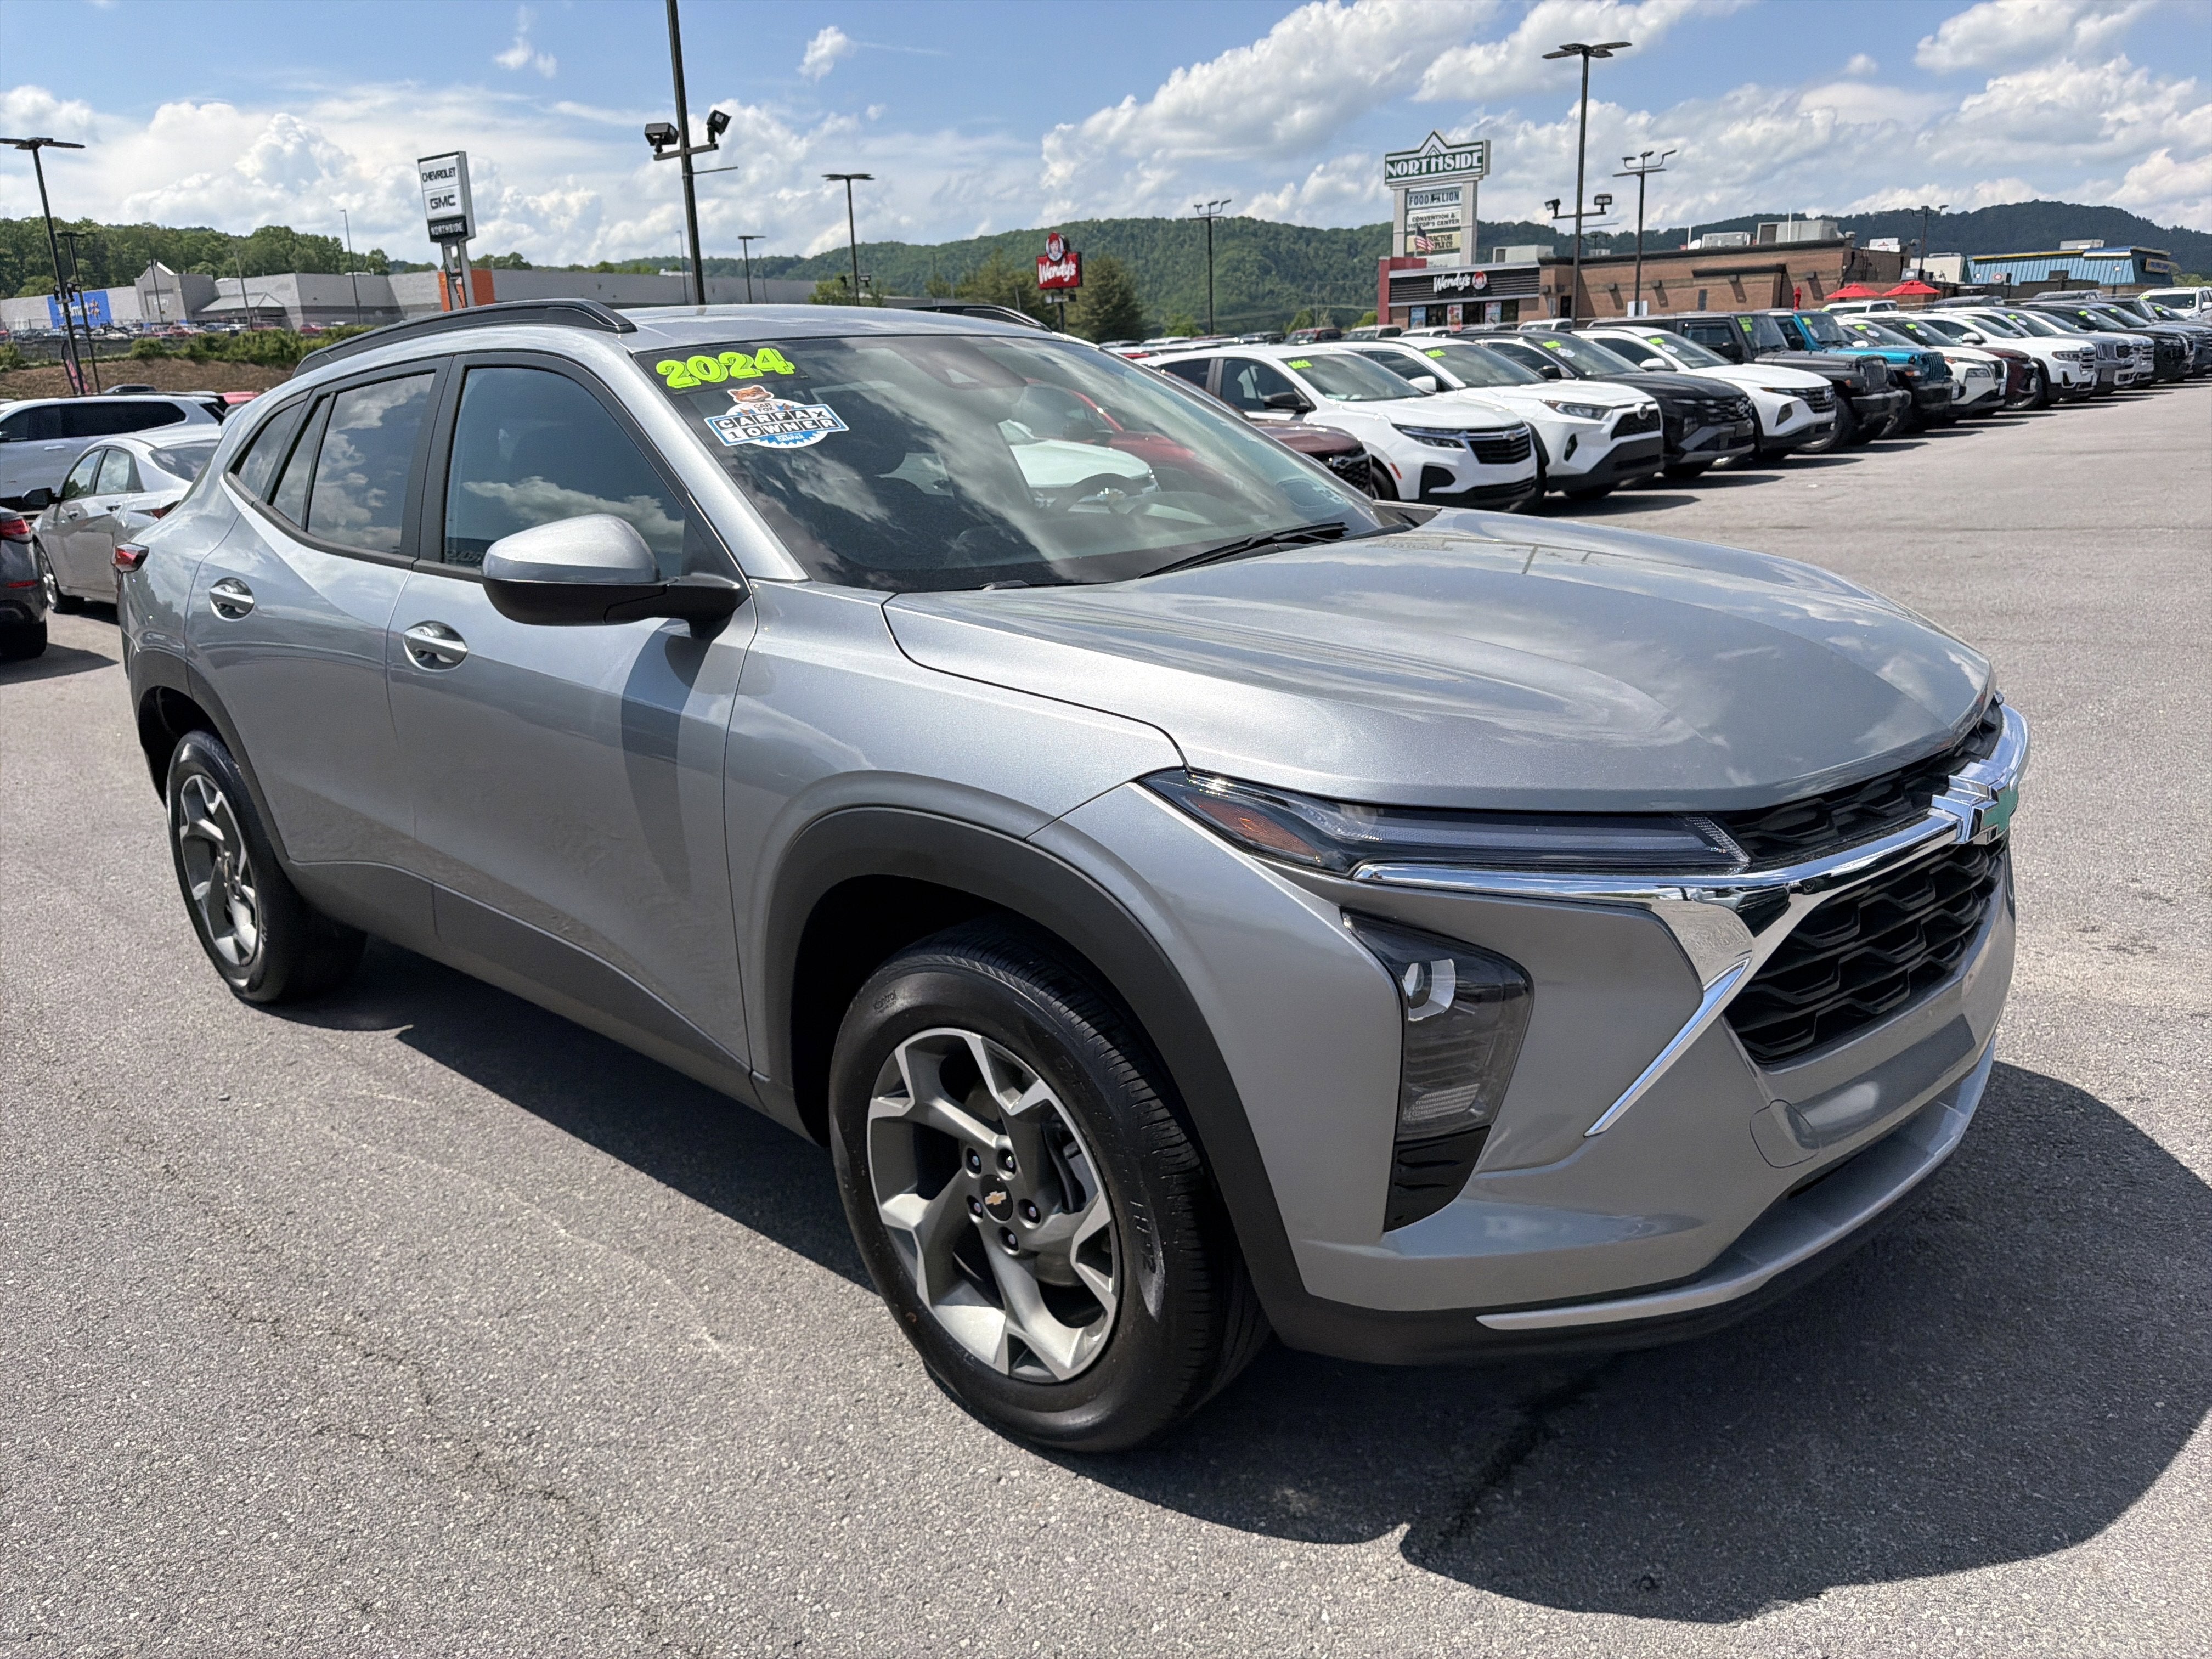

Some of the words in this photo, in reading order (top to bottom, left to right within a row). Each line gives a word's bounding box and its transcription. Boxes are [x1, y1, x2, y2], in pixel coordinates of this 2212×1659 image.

[1386, 151, 1482, 177] NORTHSIDE
[422, 167, 456, 182] CHEVROLET
[430, 194, 456, 209] GMC
[1409, 195, 1429, 206] FOOD
[1442, 191, 1459, 202] LION
[1412, 213, 1449, 222] CONVENTION
[431, 222, 463, 235] NORTHSIDE
[1038, 257, 1076, 284] Wendy's
[1433, 272, 1471, 293] Wendy's
[656, 348, 795, 389] 2024
[719, 410, 829, 428] CARFAX
[728, 431, 742, 439] 1
[747, 418, 837, 437] OWNER
